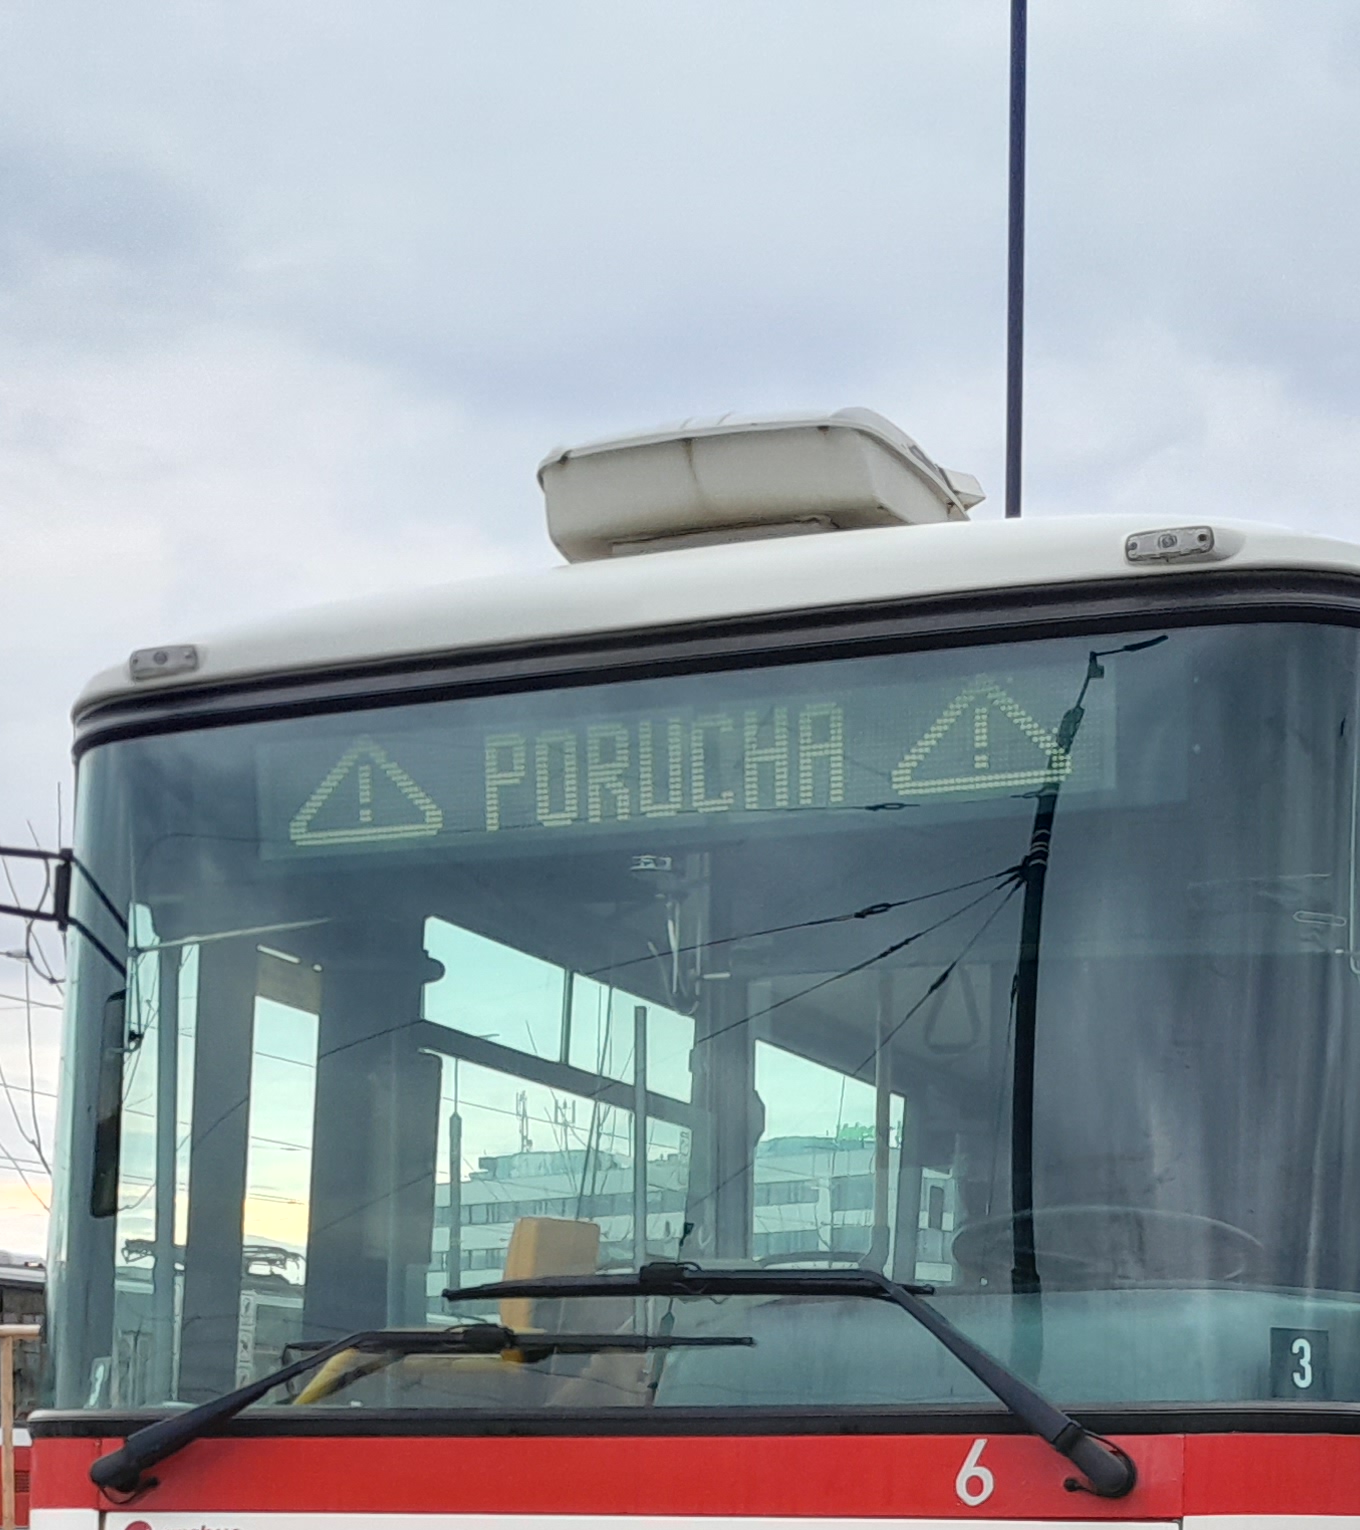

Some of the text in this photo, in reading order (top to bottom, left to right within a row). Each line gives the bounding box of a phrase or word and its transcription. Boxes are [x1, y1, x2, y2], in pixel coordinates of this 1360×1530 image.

[485, 702, 844, 832] PORUCHA
[1291, 1338, 1313, 1388] 3
[955, 1438, 995, 1507] 6
